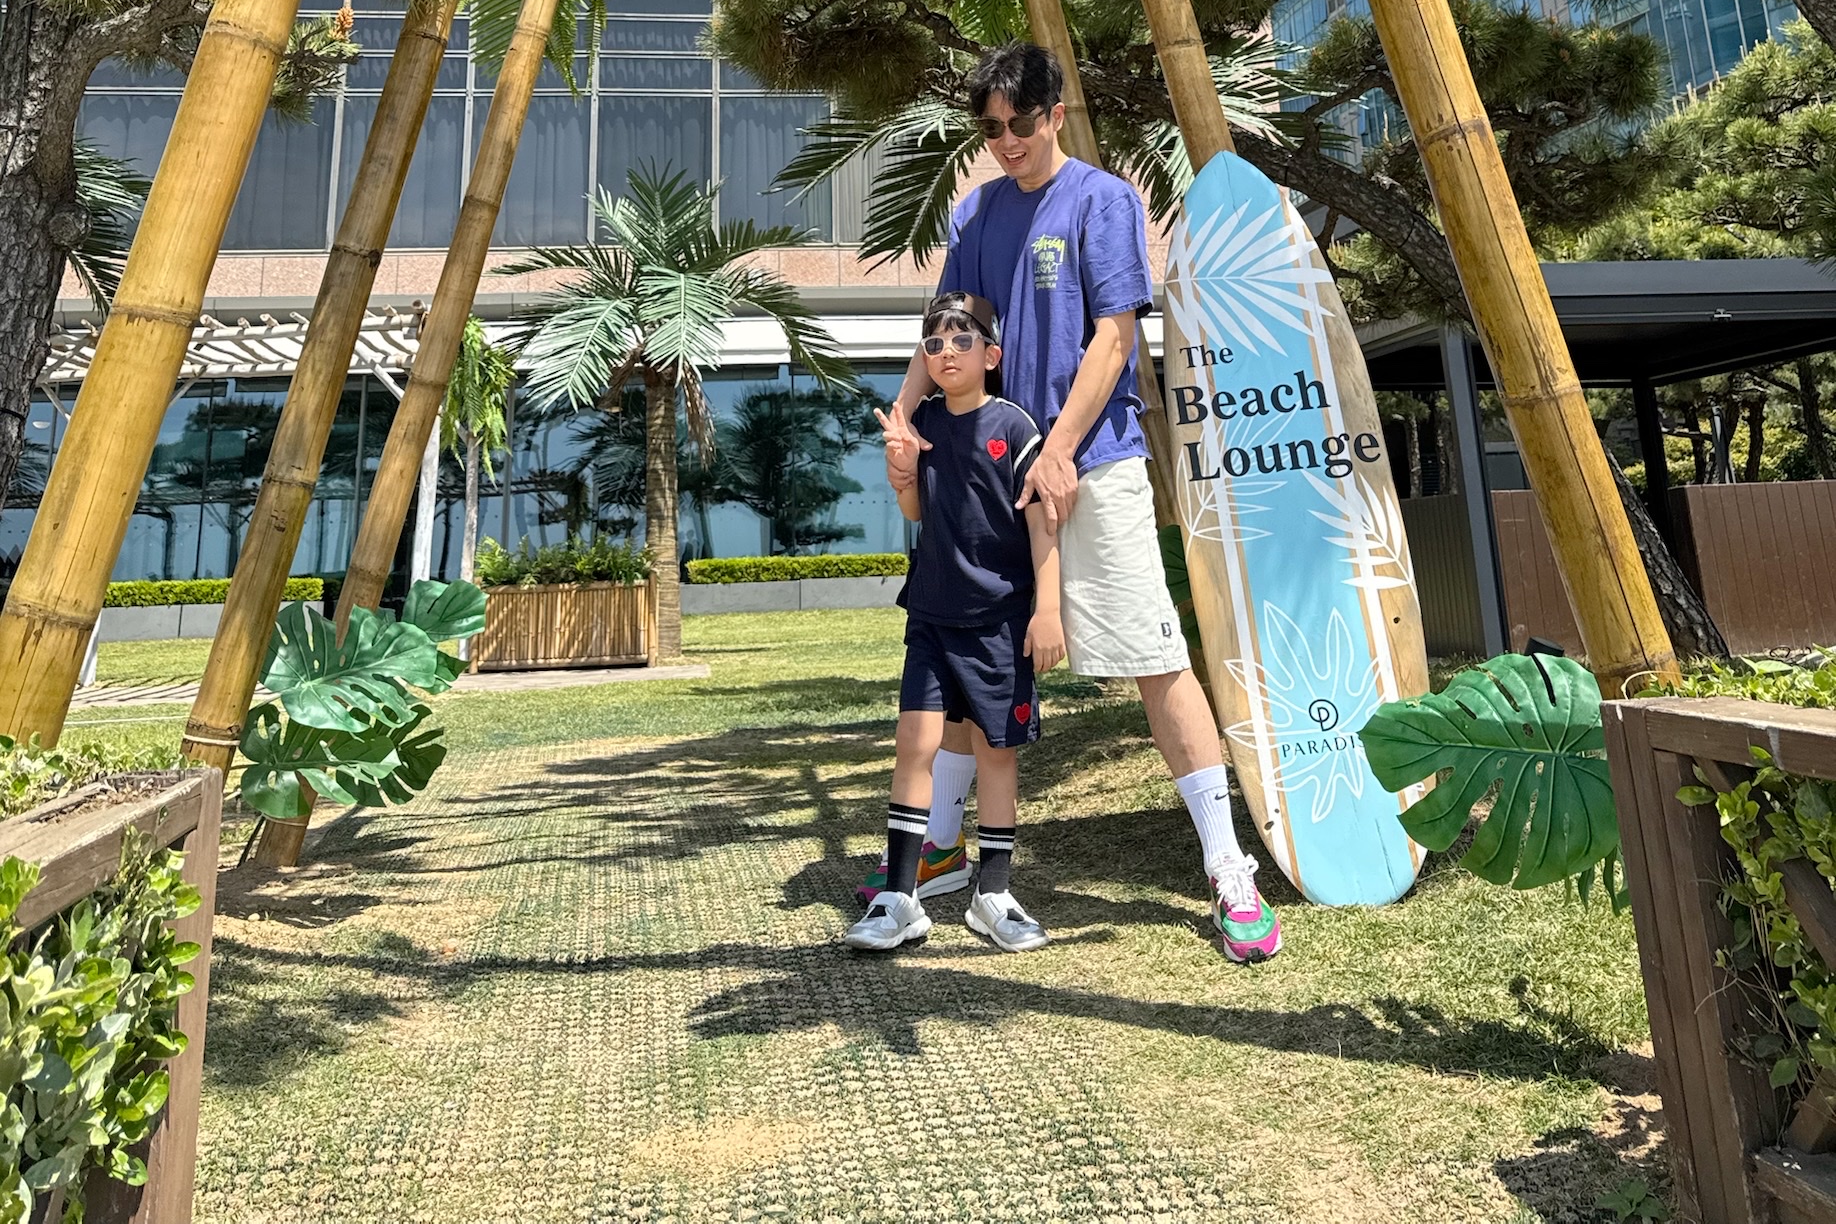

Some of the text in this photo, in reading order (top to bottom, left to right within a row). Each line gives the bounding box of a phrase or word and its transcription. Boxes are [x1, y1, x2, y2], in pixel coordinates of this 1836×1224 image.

[1179, 344, 1235, 369] The
[1171, 370, 1332, 426] Beach
[1184, 432, 1382, 482] Lounge
[1282, 735, 1365, 758] PARADI
